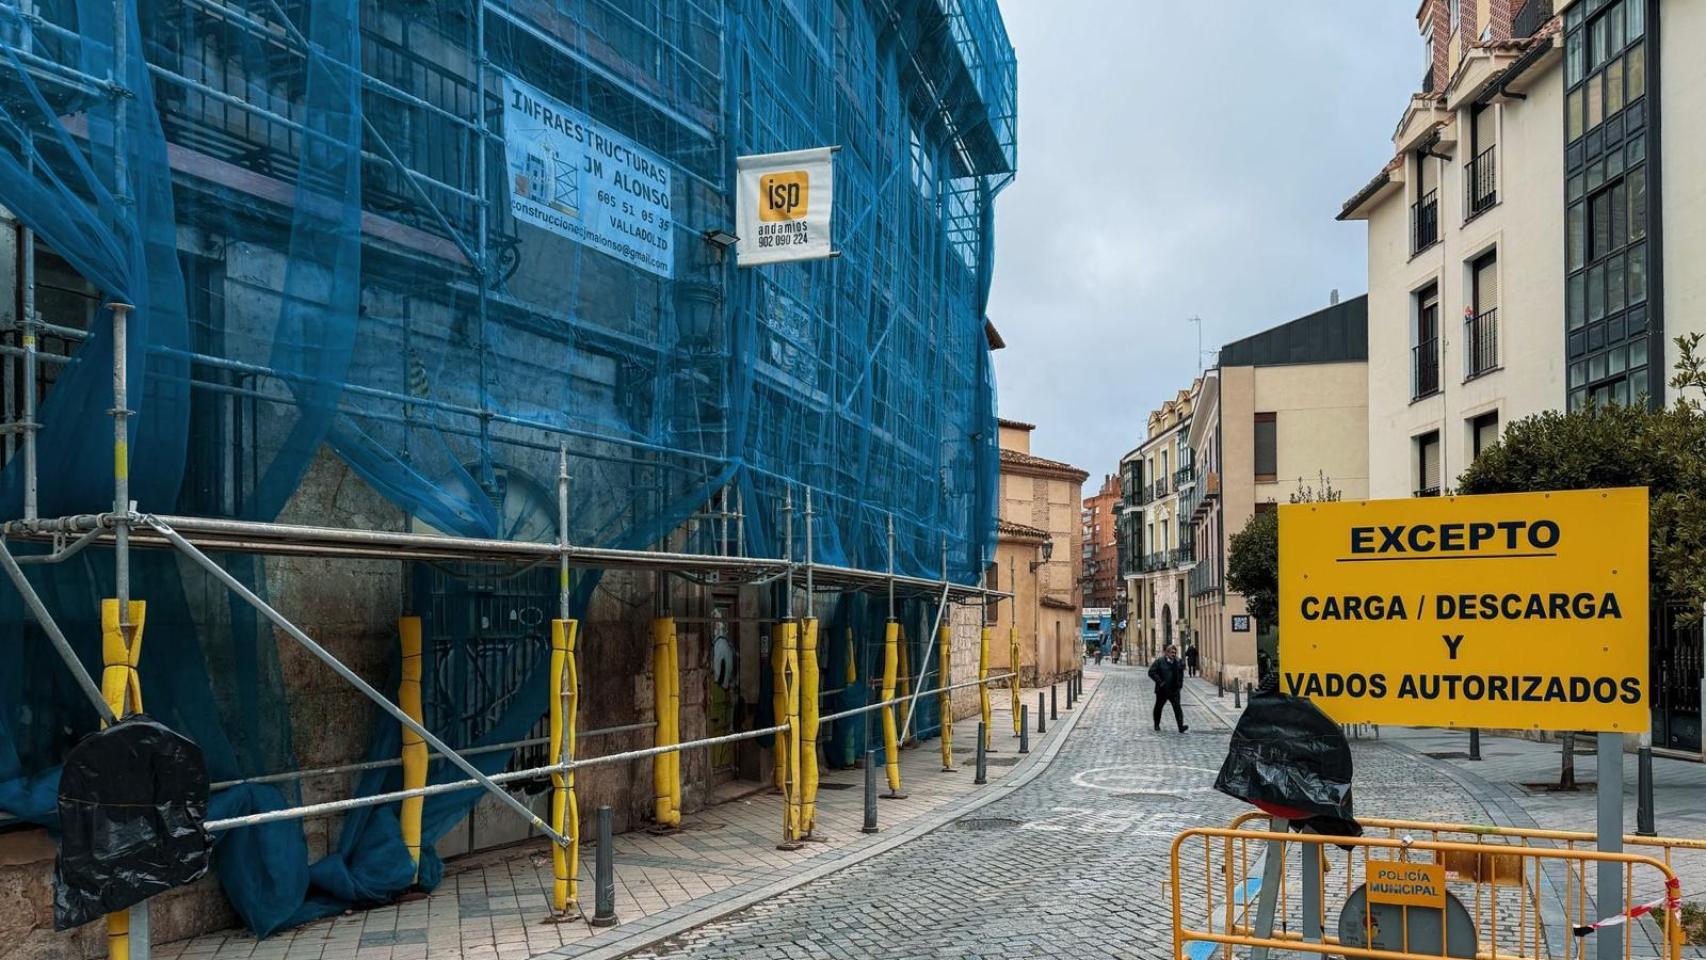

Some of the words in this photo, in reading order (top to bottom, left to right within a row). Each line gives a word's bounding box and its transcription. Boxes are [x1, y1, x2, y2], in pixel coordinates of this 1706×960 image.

[511, 88, 666, 185] INFRAESTRUCTURAS
[583, 155, 603, 179] JM
[614, 170, 670, 210] ALONSO
[768, 179, 800, 213] isp
[622, 202, 635, 216] 51
[610, 215, 668, 250] VALLADOLID
[758, 220, 808, 236] andamios
[758, 235, 774, 248] 902
[775, 234, 791, 246] 090
[793, 232, 808, 245] 224
[1350, 519, 1561, 554] EXCEPTO
[1300, 595, 1408, 621] CARGA
[1416, 594, 1426, 621] /
[1435, 592, 1623, 621] DESCARGA
[1442, 634, 1465, 660] Y
[1284, 672, 1388, 698] VADOS
[1397, 674, 1642, 704] AUTORIZADOS
[1369, 882, 1440, 897] MUNICIPAL
[1378, 868, 1431, 882] POLICÍA
